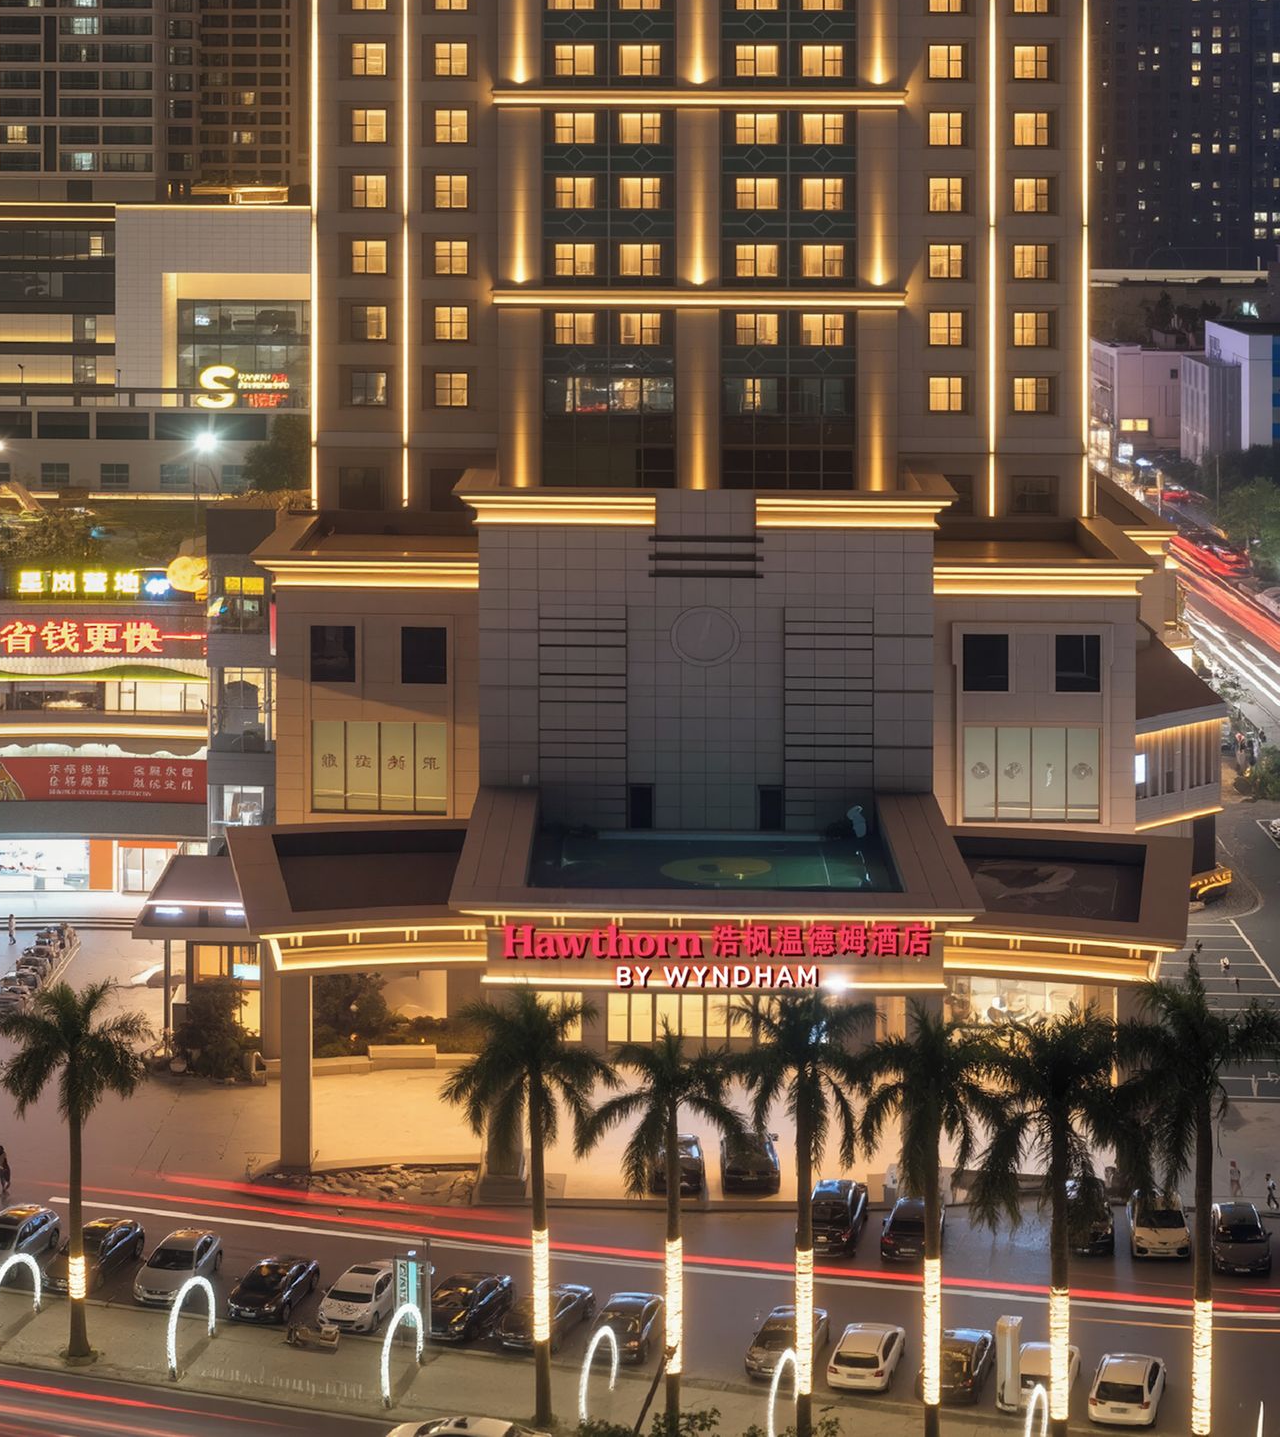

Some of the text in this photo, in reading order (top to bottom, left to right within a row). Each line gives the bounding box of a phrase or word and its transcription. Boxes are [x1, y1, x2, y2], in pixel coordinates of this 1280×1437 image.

[502, 923, 932, 960] Hawthorn 浩枫温德姆酒店
[615, 965, 820, 988] BY WYNDHAM
